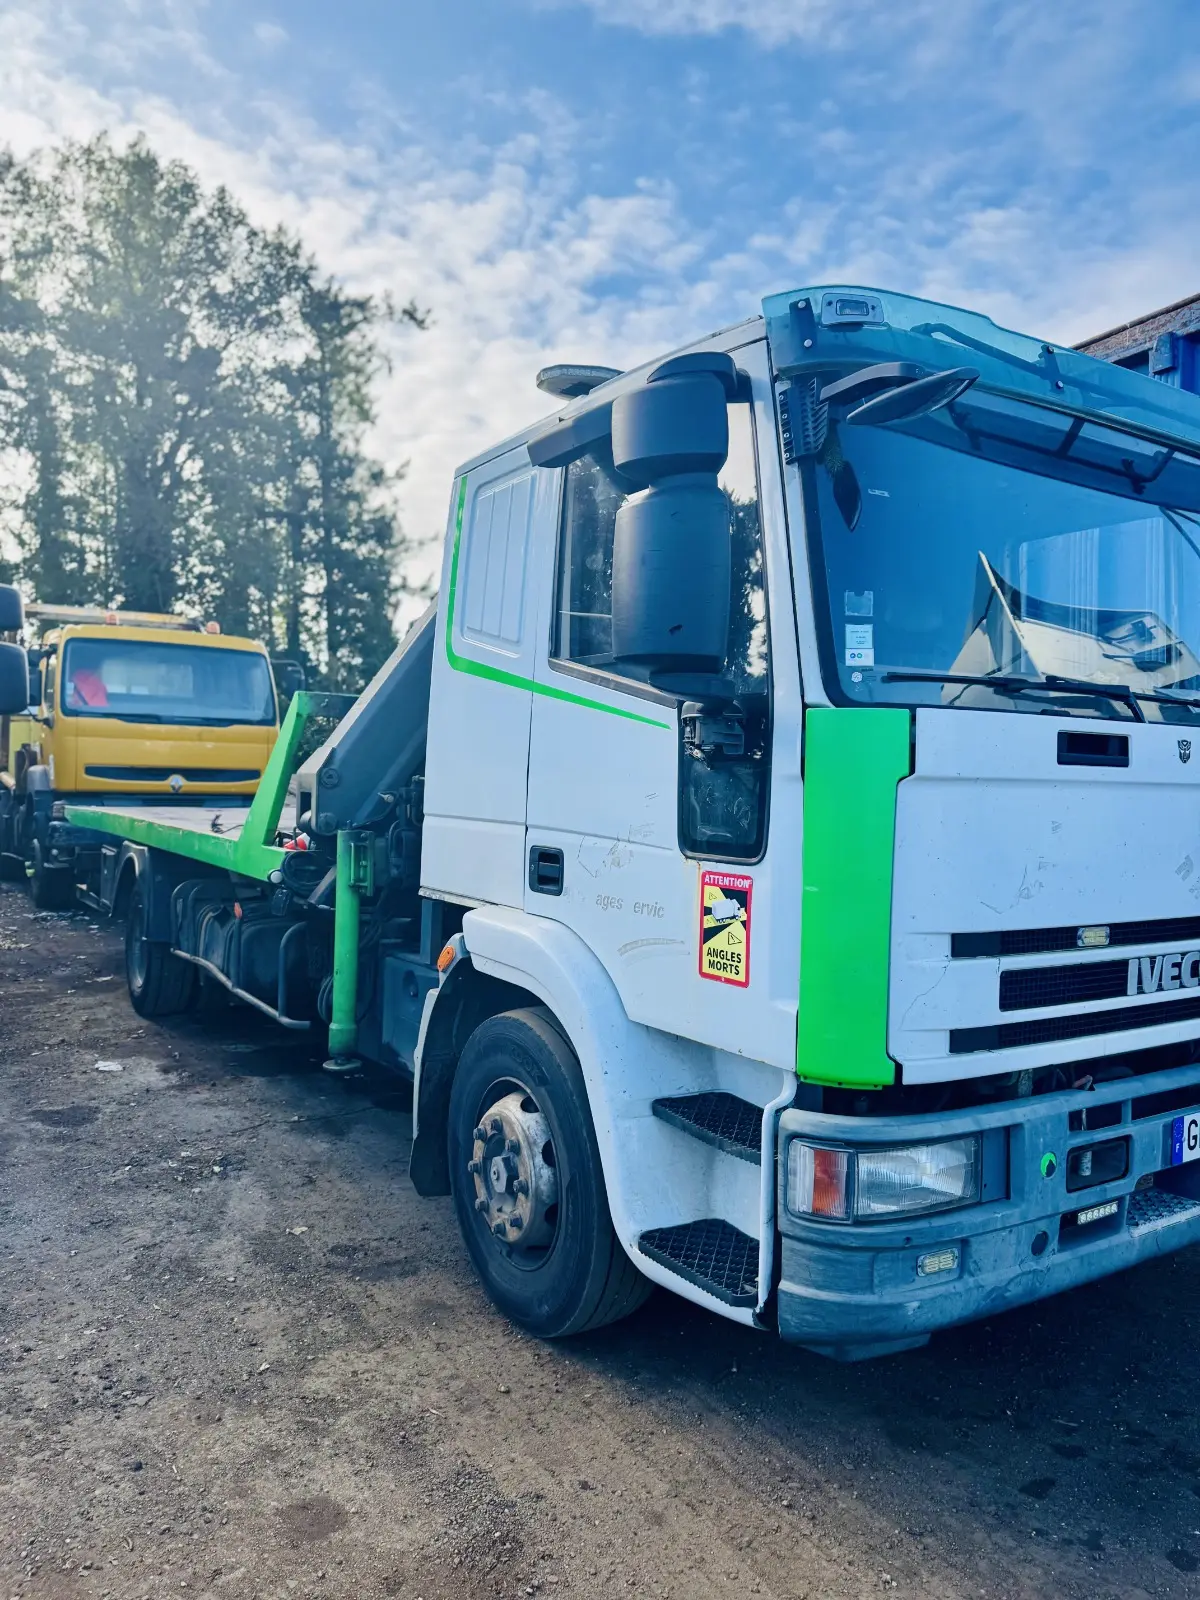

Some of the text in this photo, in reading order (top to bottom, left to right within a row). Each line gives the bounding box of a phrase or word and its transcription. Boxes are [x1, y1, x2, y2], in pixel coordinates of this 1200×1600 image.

[704, 875, 749, 889] ATTENTION
[706, 947, 742, 963] ANGLES
[708, 959, 740, 975] MORTS
[1127, 952, 1200, 995] IVEC
[1187, 1118, 1200, 1151] G
[1175, 1142, 1181, 1153] F
